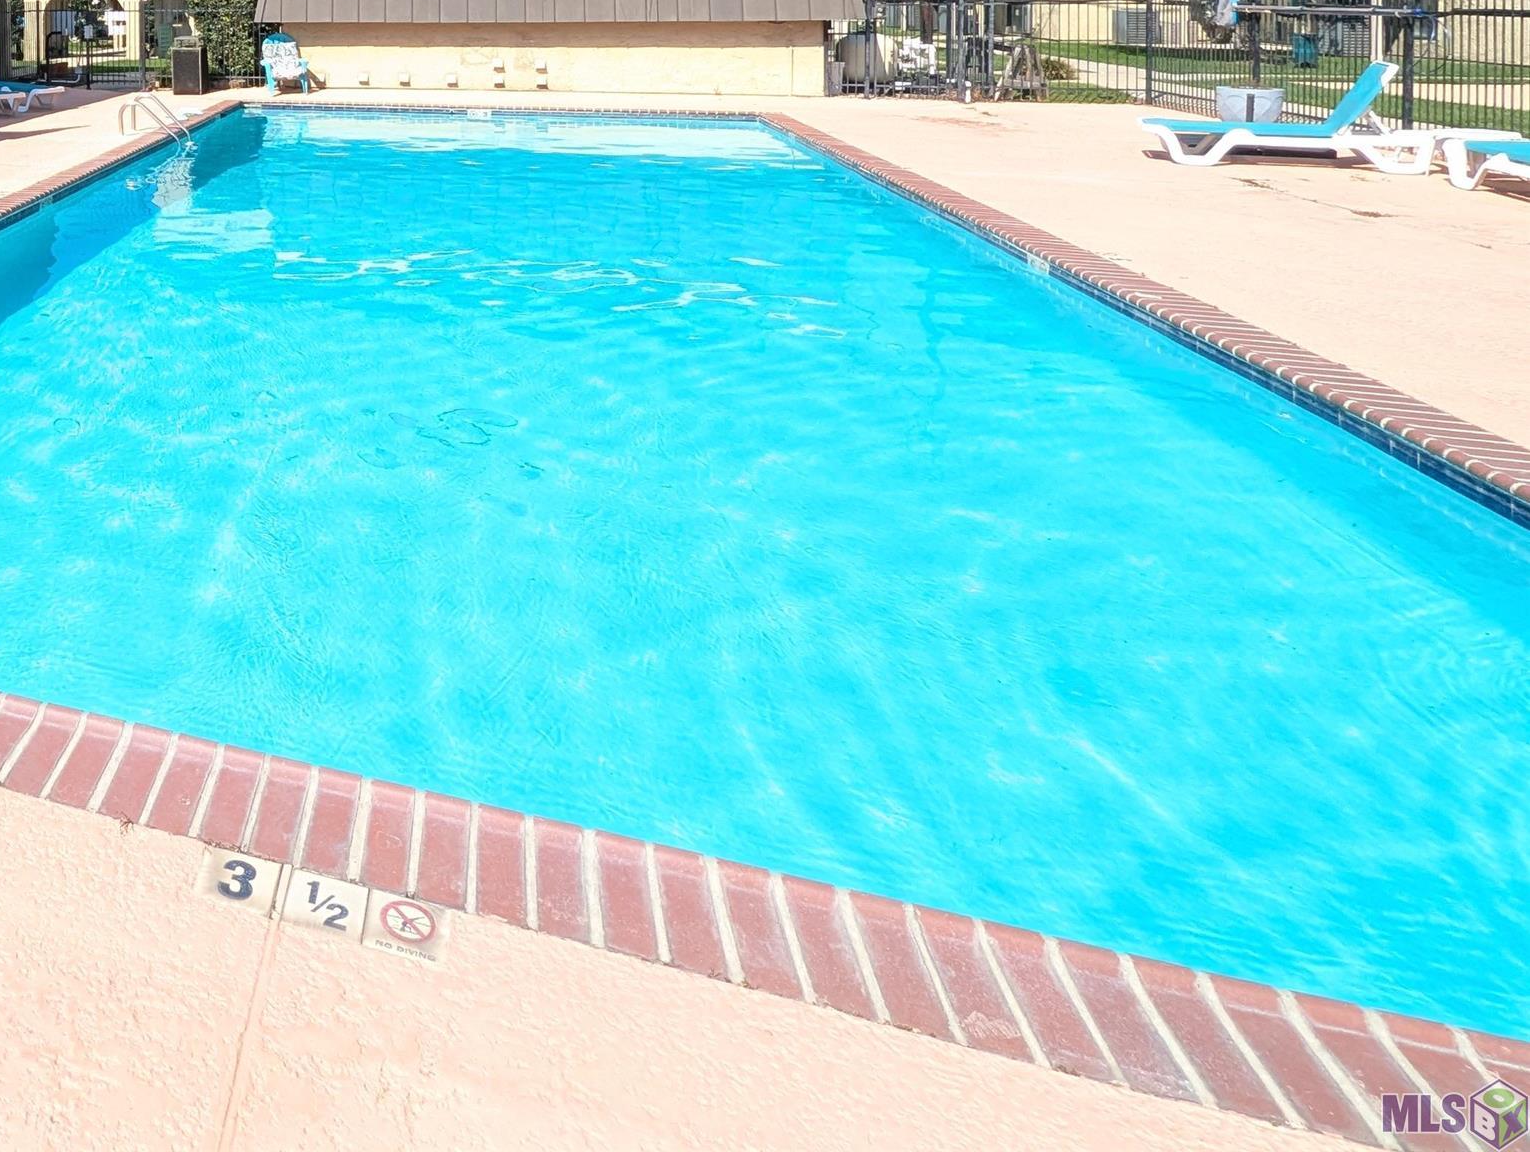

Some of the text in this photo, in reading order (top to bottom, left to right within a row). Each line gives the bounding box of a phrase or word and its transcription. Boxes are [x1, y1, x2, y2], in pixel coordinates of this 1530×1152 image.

[216, 859, 257, 901] 3
[374, 939, 437, 962] NO DIVING
